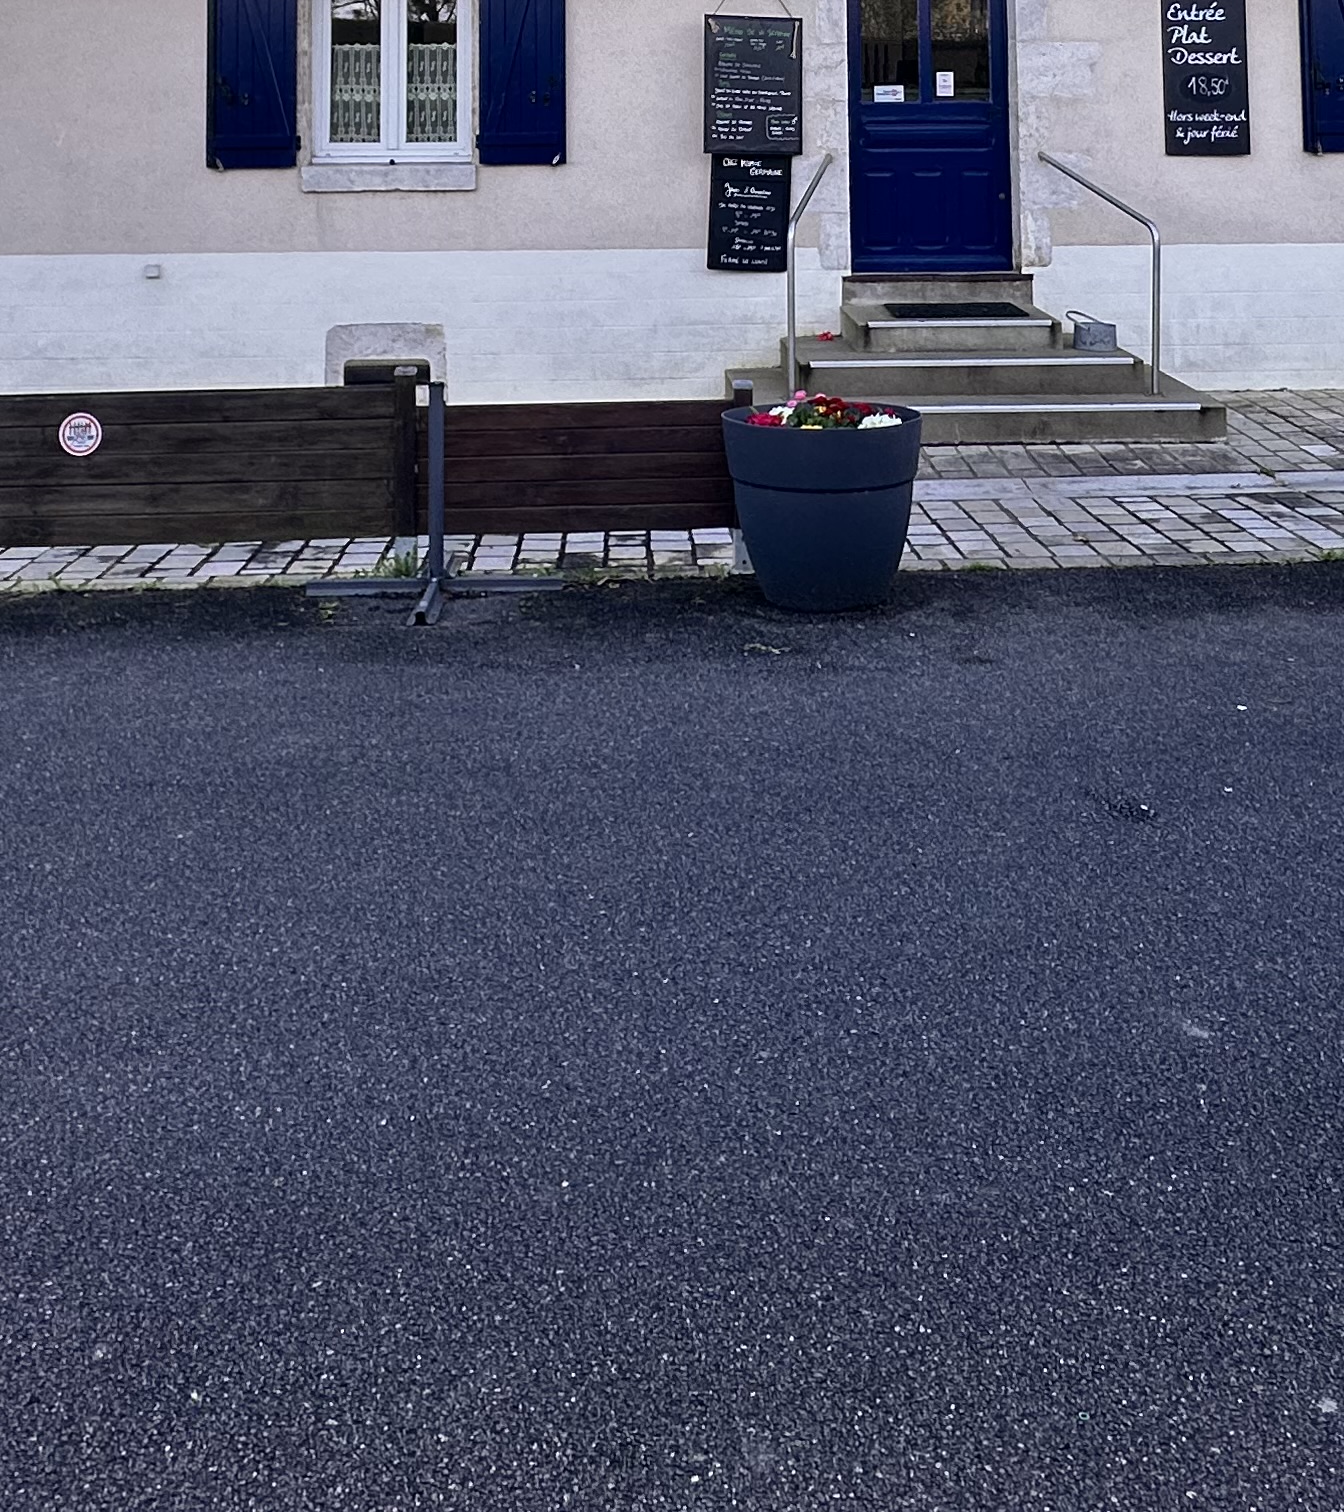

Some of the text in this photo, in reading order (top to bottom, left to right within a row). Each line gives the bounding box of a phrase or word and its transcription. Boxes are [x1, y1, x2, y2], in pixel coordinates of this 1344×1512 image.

[1166, 1, 1227, 21] Entrée
[1166, 24, 1213, 44] Plat
[1167, 46, 1243, 65] Dessert
